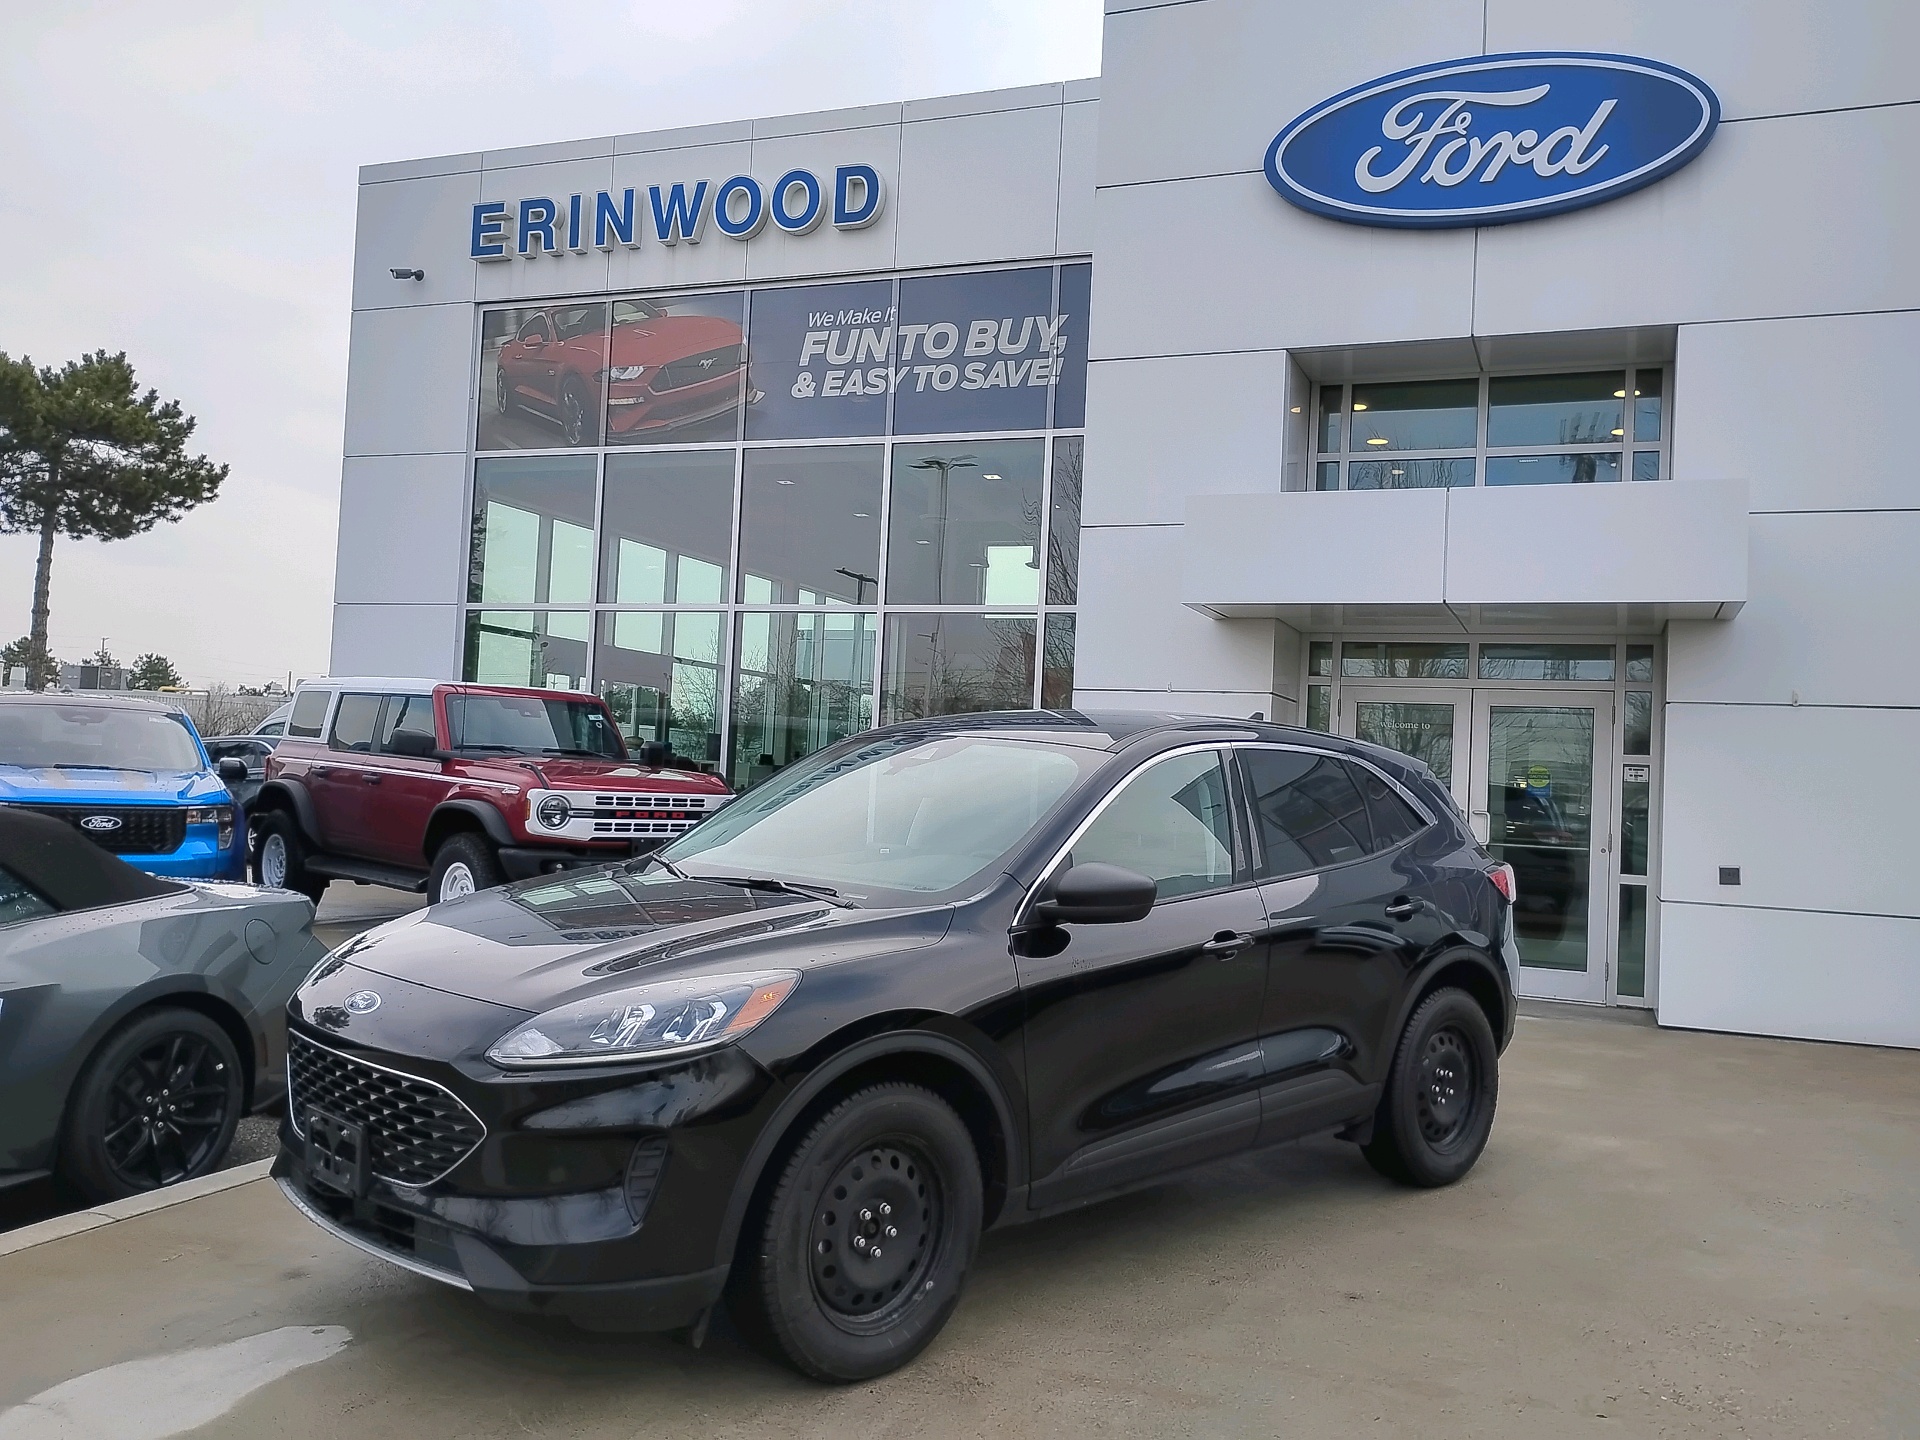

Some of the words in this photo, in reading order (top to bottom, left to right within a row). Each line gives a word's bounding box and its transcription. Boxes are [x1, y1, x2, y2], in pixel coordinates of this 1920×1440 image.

[1354, 83, 1620, 193] Ford
[471, 163, 886, 262] ERINWOOD
[808, 311, 834, 328] We
[836, 308, 881, 326] Make
[883, 305, 897, 323] It
[799, 326, 893, 366] FUN
[897, 322, 960, 360] TO
[963, 313, 1070, 357] BUY,
[791, 371, 817, 399] &
[821, 366, 911, 397] EASY
[912, 362, 960, 392] TO
[960, 357, 1065, 390] SAVE!
[1380, 719, 1419, 729] welcome
[1421, 721, 1431, 730] to
[88, 817, 115, 828] Ford
[615, 810, 686, 819] FORD
